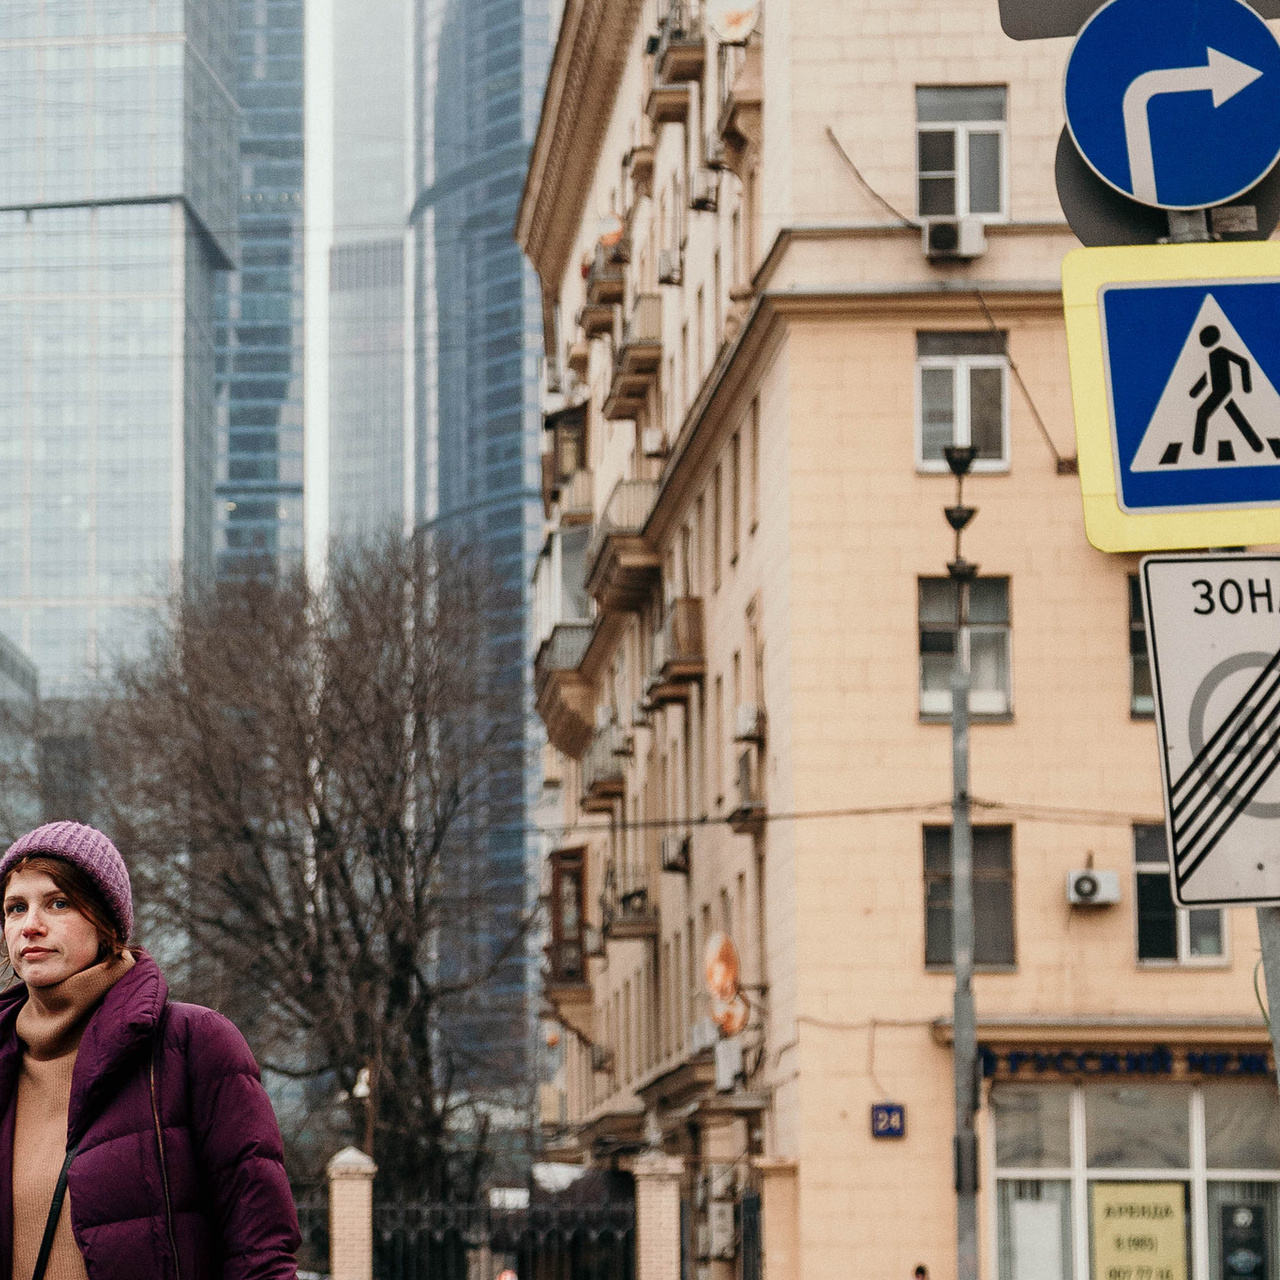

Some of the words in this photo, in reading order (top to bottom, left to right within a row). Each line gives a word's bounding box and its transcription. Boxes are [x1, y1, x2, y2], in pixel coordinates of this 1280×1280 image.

[1192, 578, 1280, 615] ЗОН
[1008, 1045, 1172, 1074] РУССКИЙ
[877, 1111, 901, 1130] 24
[1105, 1203, 1174, 1220] АРЕНДА
